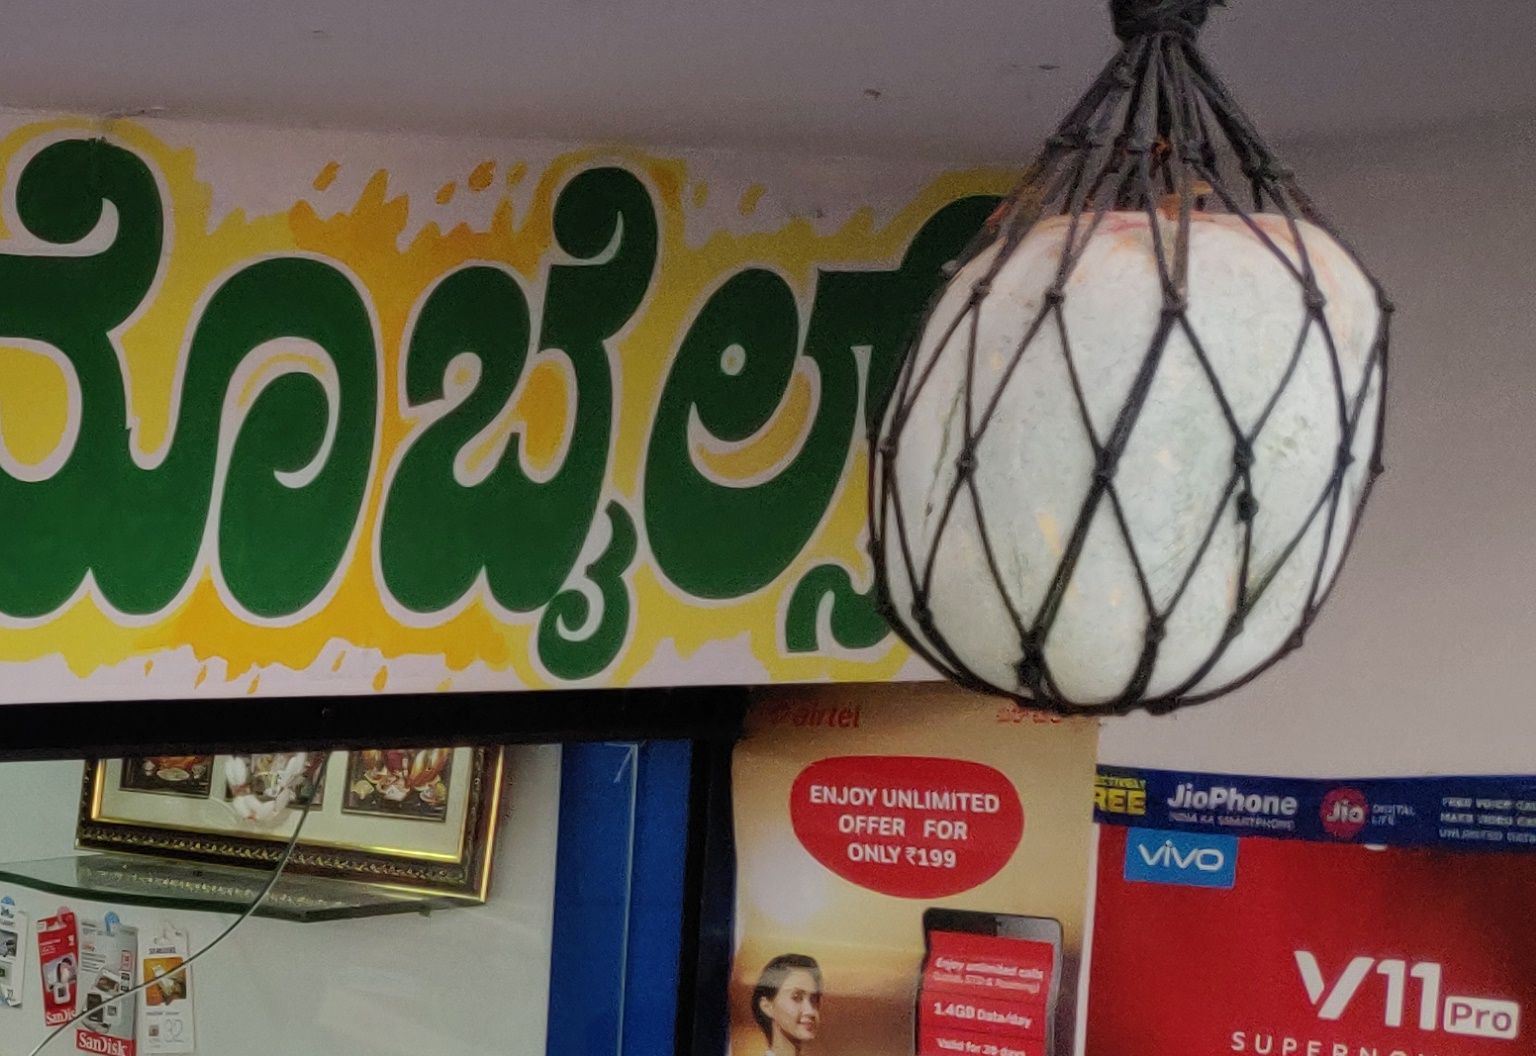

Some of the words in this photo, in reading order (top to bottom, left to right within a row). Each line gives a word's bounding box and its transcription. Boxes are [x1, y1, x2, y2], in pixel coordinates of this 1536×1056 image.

[810, 785, 877, 807] ENJOY
[882, 788, 1000, 813] UNLIMITED
[1167, 782, 1298, 816] JioPhone
[1326, 799, 1365, 823] Jio
[838, 815, 905, 836] OFFER
[923, 820, 968, 840] FOR
[848, 844, 901, 863] ONLY
[1138, 839, 1224, 871] vivo
[1294, 950, 1441, 1031] V11
[1450, 1003, 1513, 1032] Pro
